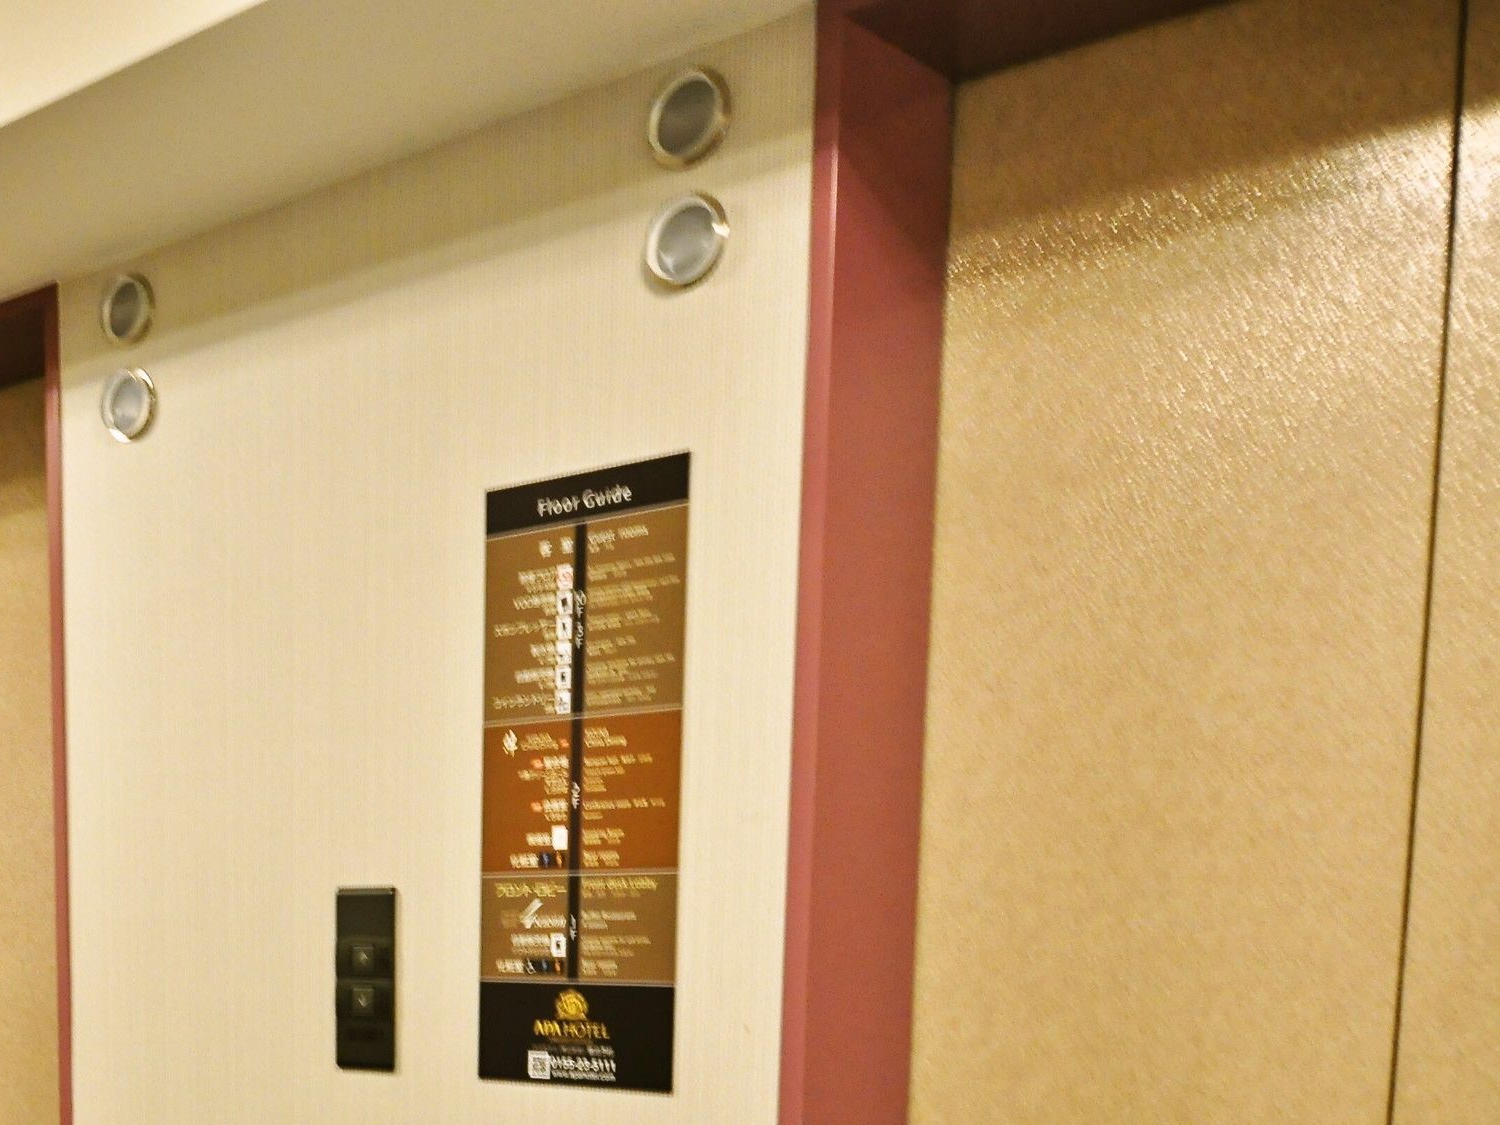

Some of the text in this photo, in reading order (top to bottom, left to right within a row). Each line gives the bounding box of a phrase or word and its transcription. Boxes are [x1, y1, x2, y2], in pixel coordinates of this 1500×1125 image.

[537, 483, 632, 517] Floor Guide
[534, 1019, 610, 1040] APA HOTEL
